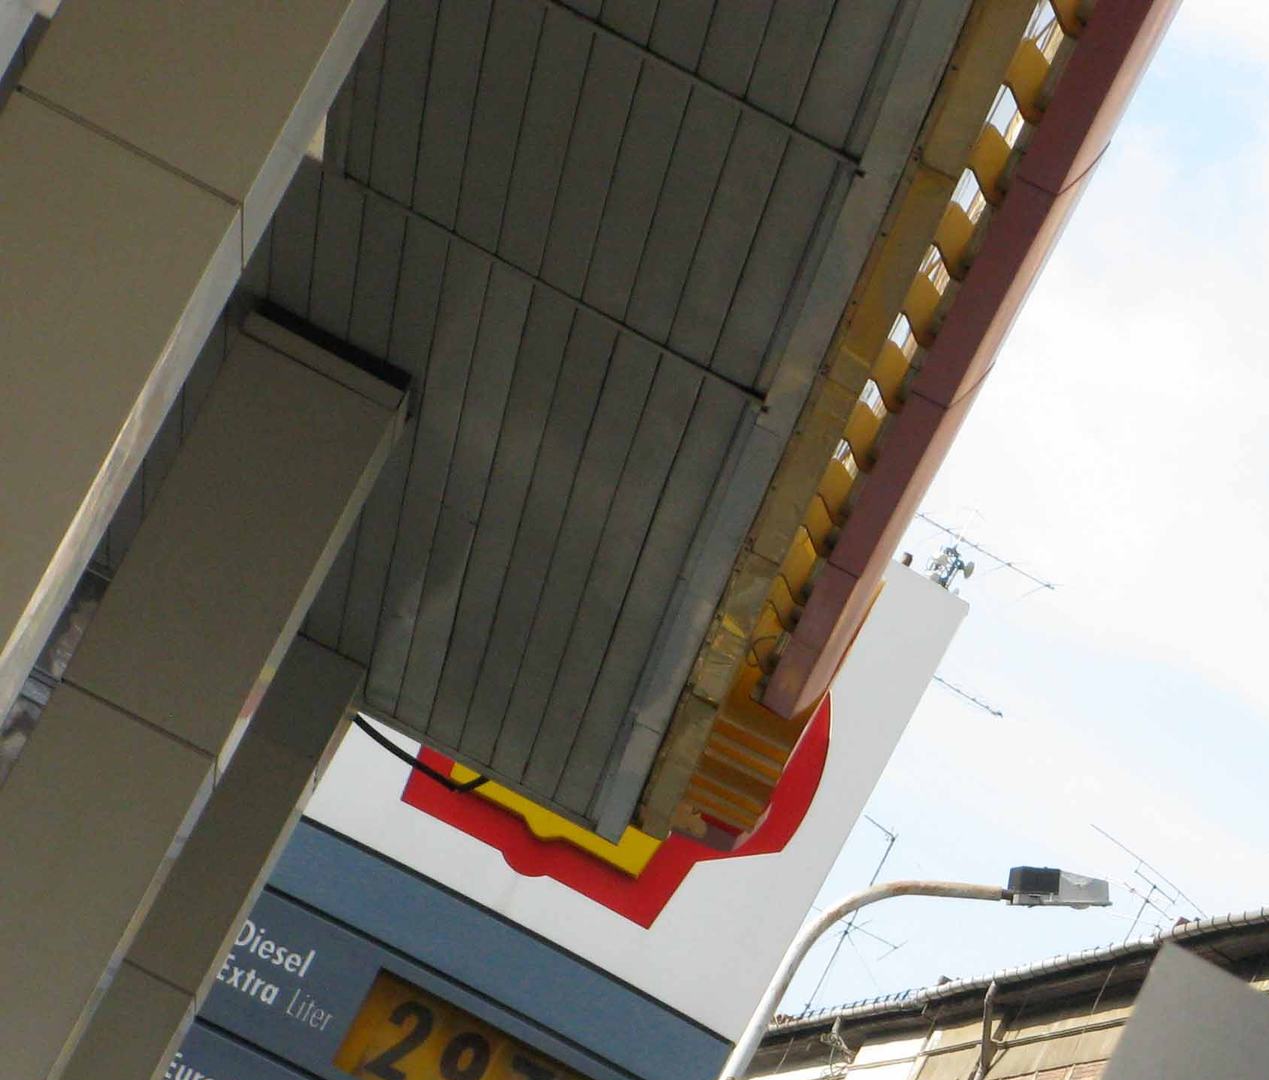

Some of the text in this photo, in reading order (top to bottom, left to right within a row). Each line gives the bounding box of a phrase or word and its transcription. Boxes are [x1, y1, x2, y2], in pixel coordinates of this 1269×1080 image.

[233, 919, 316, 979] Diesel
[215, 953, 334, 1032] Extra Liter
